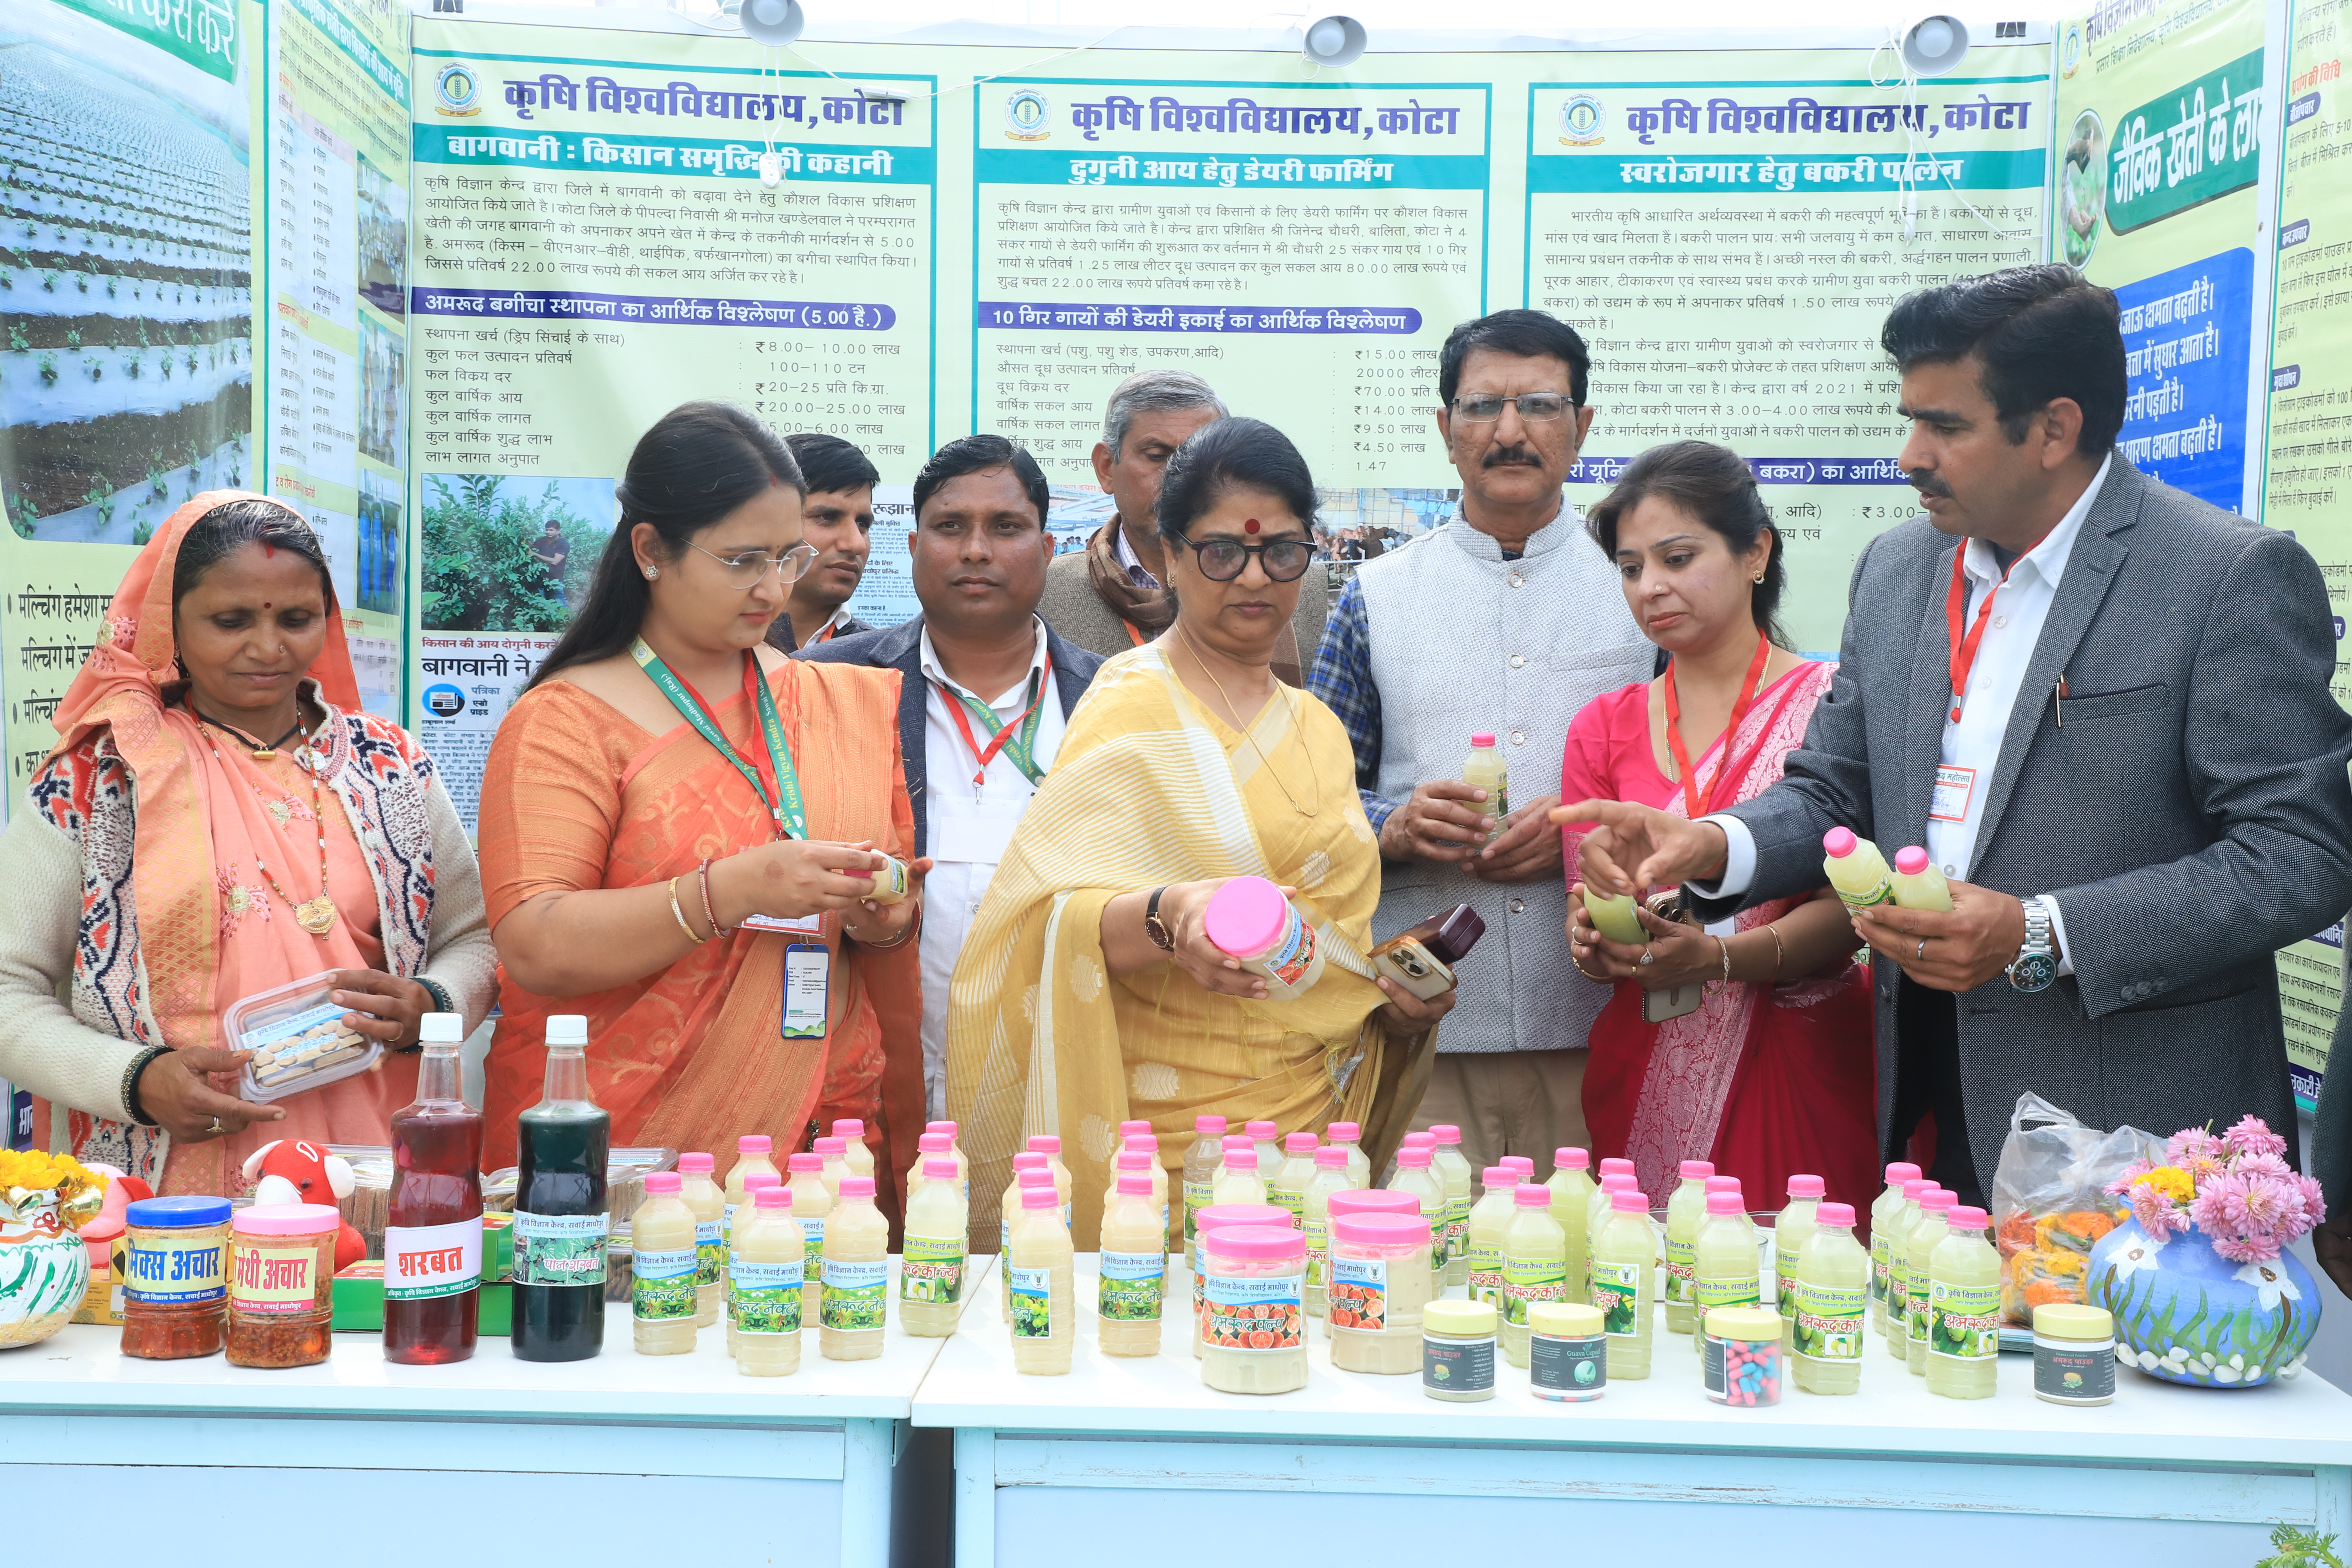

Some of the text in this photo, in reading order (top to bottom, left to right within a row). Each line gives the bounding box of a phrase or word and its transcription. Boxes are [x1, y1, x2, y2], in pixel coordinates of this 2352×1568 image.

[503, 74, 580, 119] कृषि
[1071, 96, 1144, 141] कृषि
[1626, 99, 1701, 145] कृषि
[2114, 77, 2231, 204] जैविक खेती के
[447, 136, 893, 175] बागवानी किसान समृद्धि कहानी
[1069, 156, 1394, 187] दुगुनी आय हेतु डेयरी फार्मिंग
[1620, 157, 1964, 190] स्वरोजगार हेतु बकरी पालन
[423, 175, 916, 208] कृषि विज्ञान केन्द्र द्वारा जिले में बागवानी को बढ़ावा देने हेतु कौशल विकास प्रशिक्षण
[997, 200, 1114, 216] कृषि विज्ञान केन्द्र द्वारा
[1571, 208, 1776, 225] भारतीय कृषि आधारित अर्थव्यवस्था में
[426, 296, 485, 312] अमरूद
[489, 292, 545, 312] बगीचा
[550, 299, 617, 315] स्थापना
[621, 303, 645, 317] का
[651, 299, 713, 319] आर्थिक
[717, 301, 795, 322] विश्लेषण
[2145, 280, 2200, 328] क्षमता बढ़ती
[994, 305, 1406, 330] 10 गिर गायों की डेयरी इकाई का आर्थिक विश्लेषण
[424, 349, 572, 363] कुल फल उत्पादन प्रतिवर्ष
[2144, 332, 2205, 380] में सुधार आता
[996, 380, 1070, 395] दूध विक्रय दर
[18, 583, 98, 623] मल्चिंग हमेशा
[21, 634, 75, 672] मल्चिंग में
[422, 637, 531, 651] किसान की आय दोगुनी
[421, 654, 531, 677] बागवानी ने
[471, 685, 500, 695] पत्रिका
[661, 673, 679, 693] (Raj.)
[677, 692, 706, 726] Madhopur
[704, 724, 722, 742] Sawai
[763, 696, 798, 808] Krishi Vigyan Kendra Sawai
[1947, 772, 1971, 782] महोत्सव
[521, 1218, 529, 1228] कृषि
[531, 1219, 549, 1228] विज्ञान
[171, 1246, 220, 1280] अचार
[237, 1247, 308, 1289] मेथी अचार
[398, 1246, 463, 1276] शरबत
[544, 1258, 599, 1271] पान शरबत
[922, 1265, 938, 1277] का
[1347, 1264, 1366, 1275] माधोपुर
[140, 1292, 150, 1301] कृषि
[201, 1290, 217, 1298] माधोपुर
[404, 1289, 415, 1297] कृषि
[1216, 1280, 1231, 1289] विज्ञान
[1249, 1282, 1266, 1292] सवाई
[1267, 1282, 1288, 1292] माधोपुर
[1256, 1318, 1285, 1331] पल्प
[1799, 1312, 1857, 1332] अमरूद का
[1945, 1314, 1988, 1331] अमरूद
